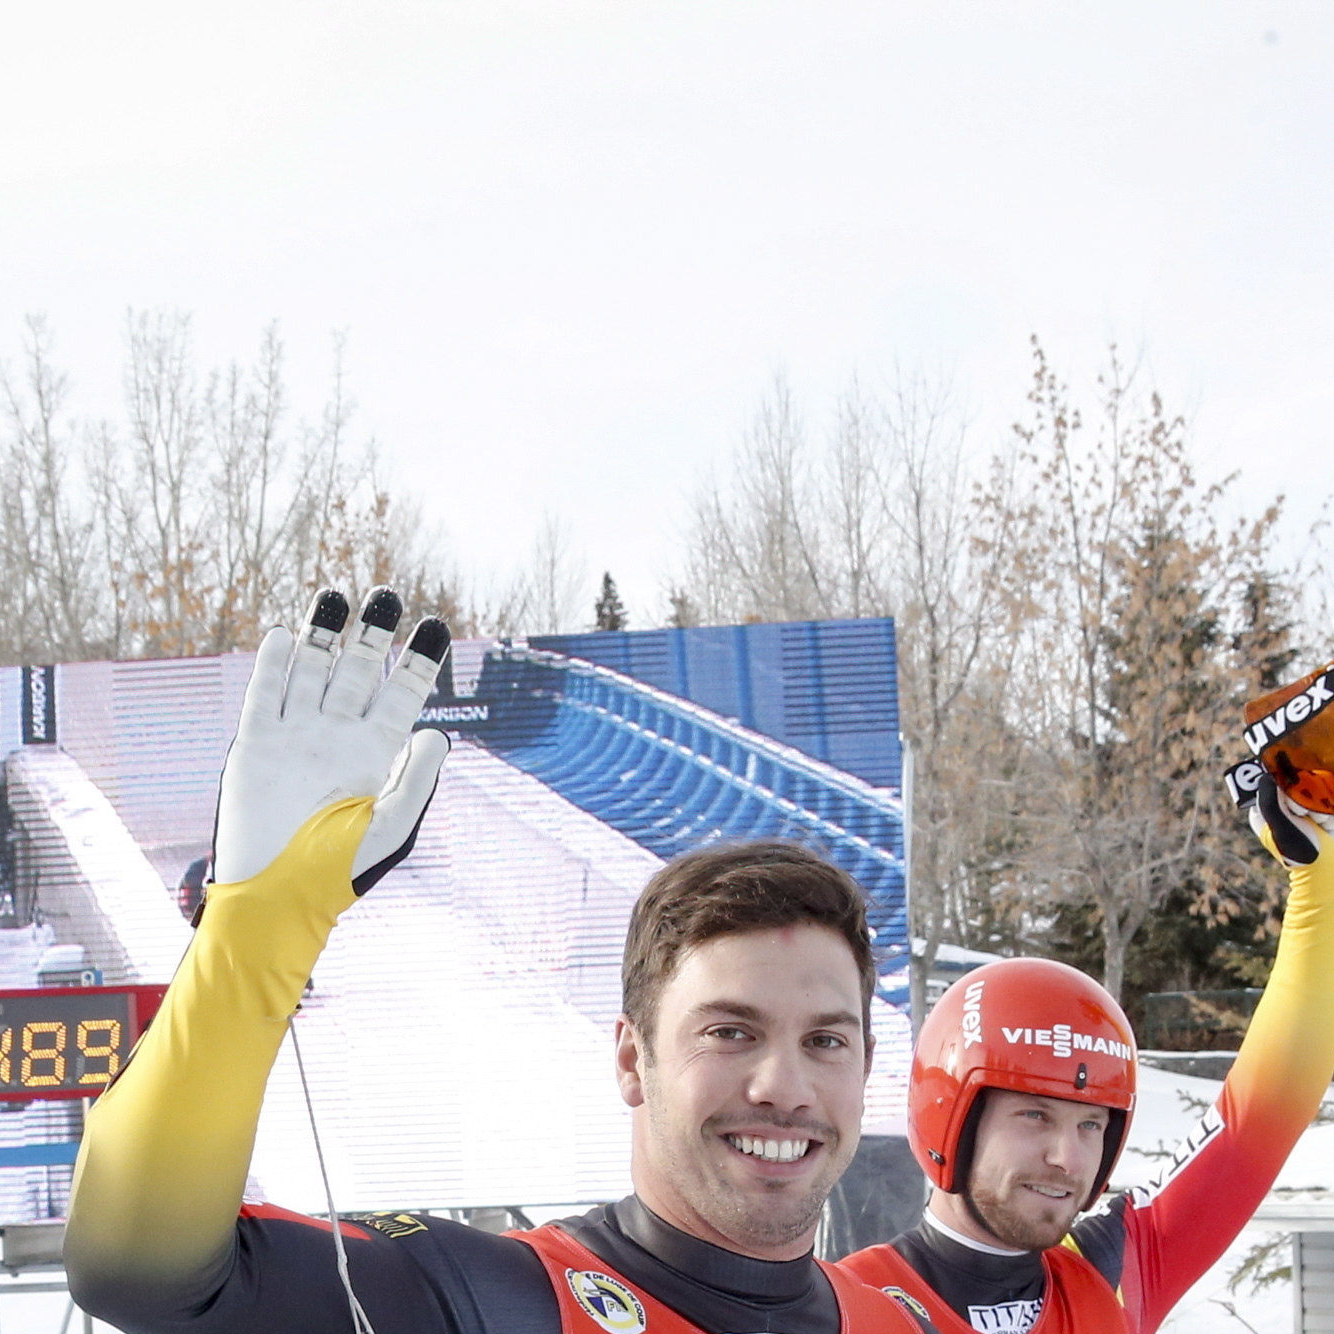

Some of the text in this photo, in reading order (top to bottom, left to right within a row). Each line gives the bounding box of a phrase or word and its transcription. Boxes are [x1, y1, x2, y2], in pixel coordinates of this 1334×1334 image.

[1244, 675, 1334, 756] uvex
[962, 980, 985, 1049] uvex
[1001, 1023, 1132, 1061] VIESSMANN
